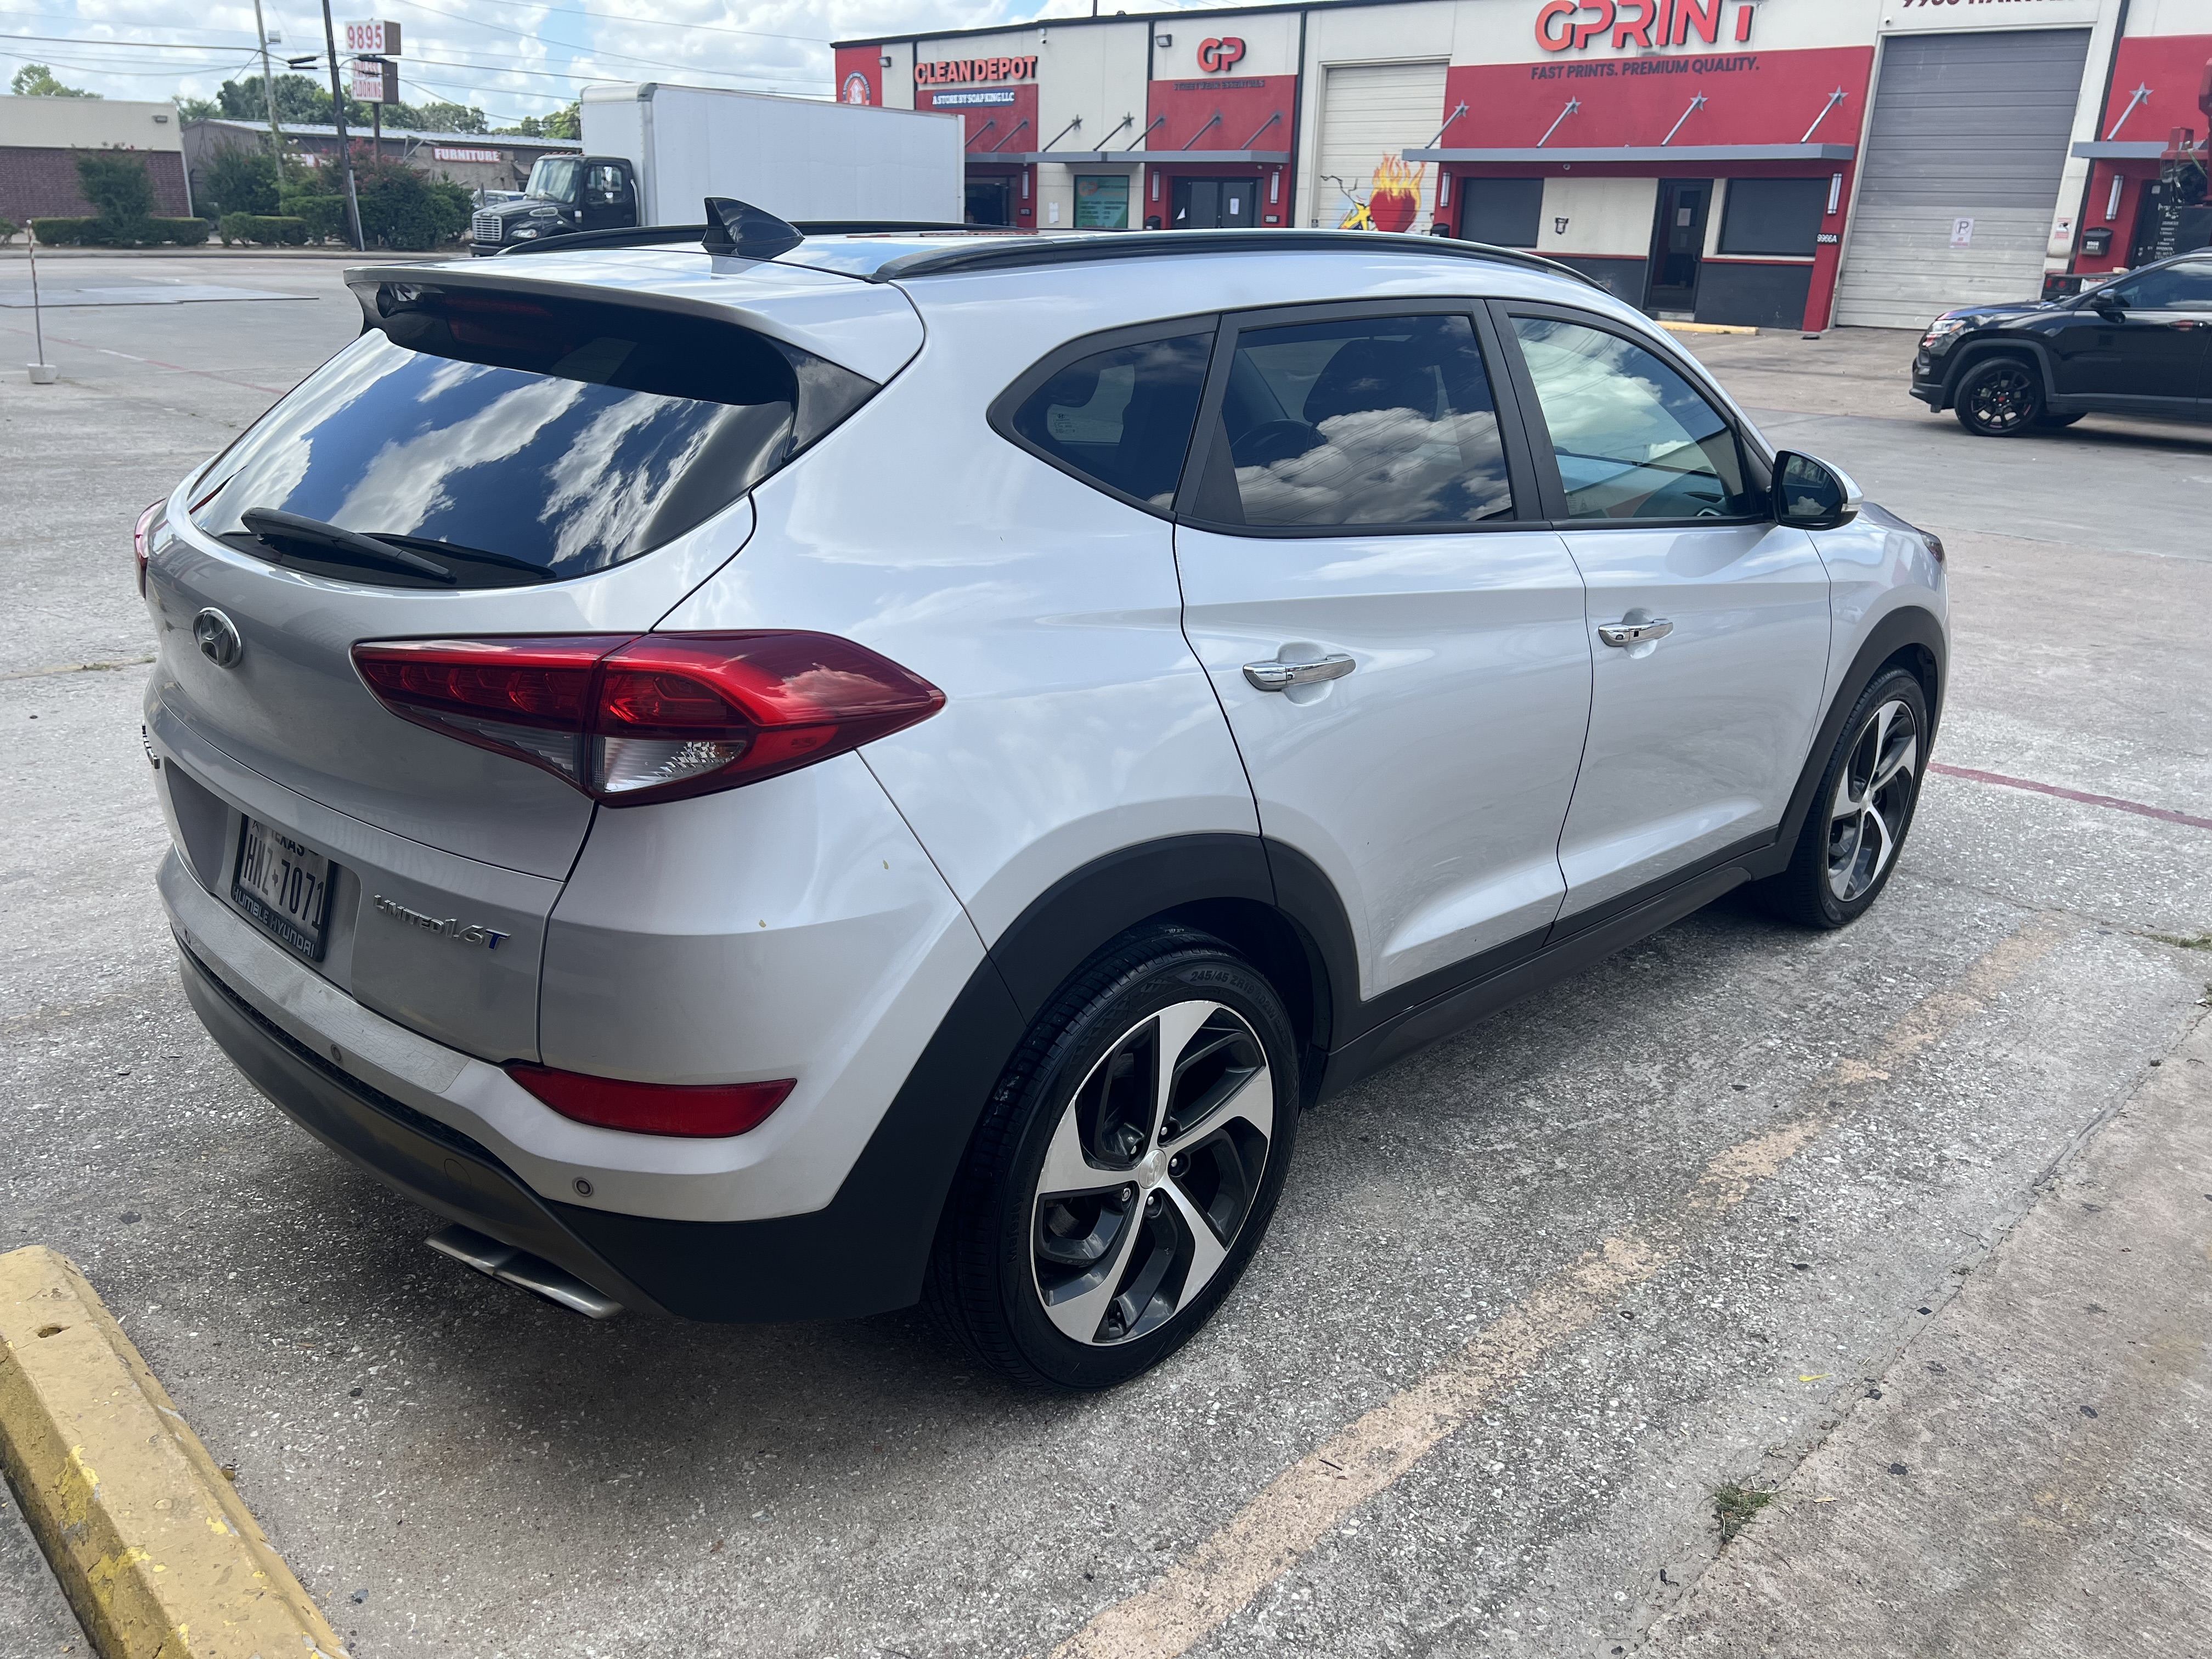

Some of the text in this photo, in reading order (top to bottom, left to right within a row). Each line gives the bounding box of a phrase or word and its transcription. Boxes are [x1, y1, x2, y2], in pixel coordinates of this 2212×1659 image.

[348, 25, 382, 49] 9895
[1197, 37, 1245, 72] GP
[1531, 56, 1759, 80] FAST PRINTS. PREMIUM QUALITY.
[914, 55, 1037, 84] CLEAN DEPOT
[434, 148, 501, 163] FURNITURE
[233, 886, 315, 958] HUMBLE HYUNDAI
[373, 894, 444, 934] LIMITED
[1189, 970, 1230, 983] 245/45
[1229, 975, 1255, 995] ZR19
